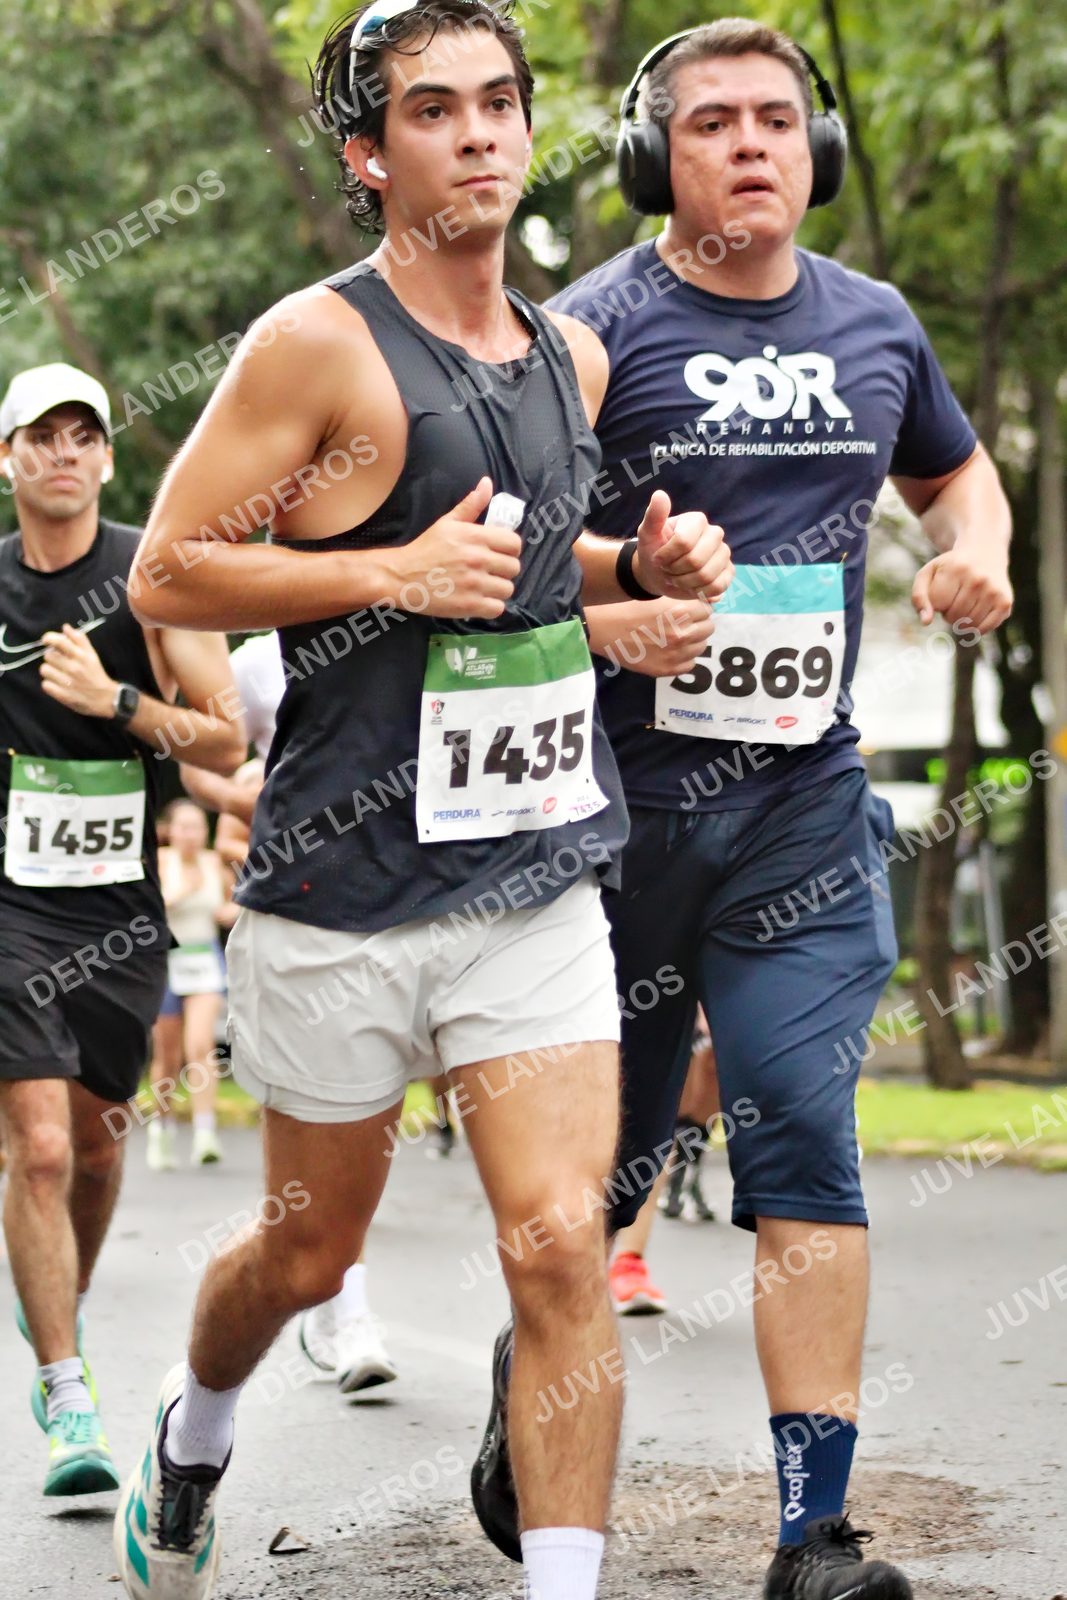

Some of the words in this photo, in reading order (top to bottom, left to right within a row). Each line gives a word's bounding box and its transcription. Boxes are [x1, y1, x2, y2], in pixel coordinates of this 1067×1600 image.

[696, 420, 855, 435] REHANOVA
[709, 444, 726, 456] DE
[727, 441, 819, 456] REHABILITACIÓN
[821, 441, 876, 455] DEPORTIVA
[670, 646, 833, 699] 5869
[668, 707, 714, 721] PERDURA
[443, 708, 586, 788] 1435
[433, 808, 481, 821] PERDURA
[24, 816, 134, 855] 1455
[783, 1443, 810, 1501] coflex
